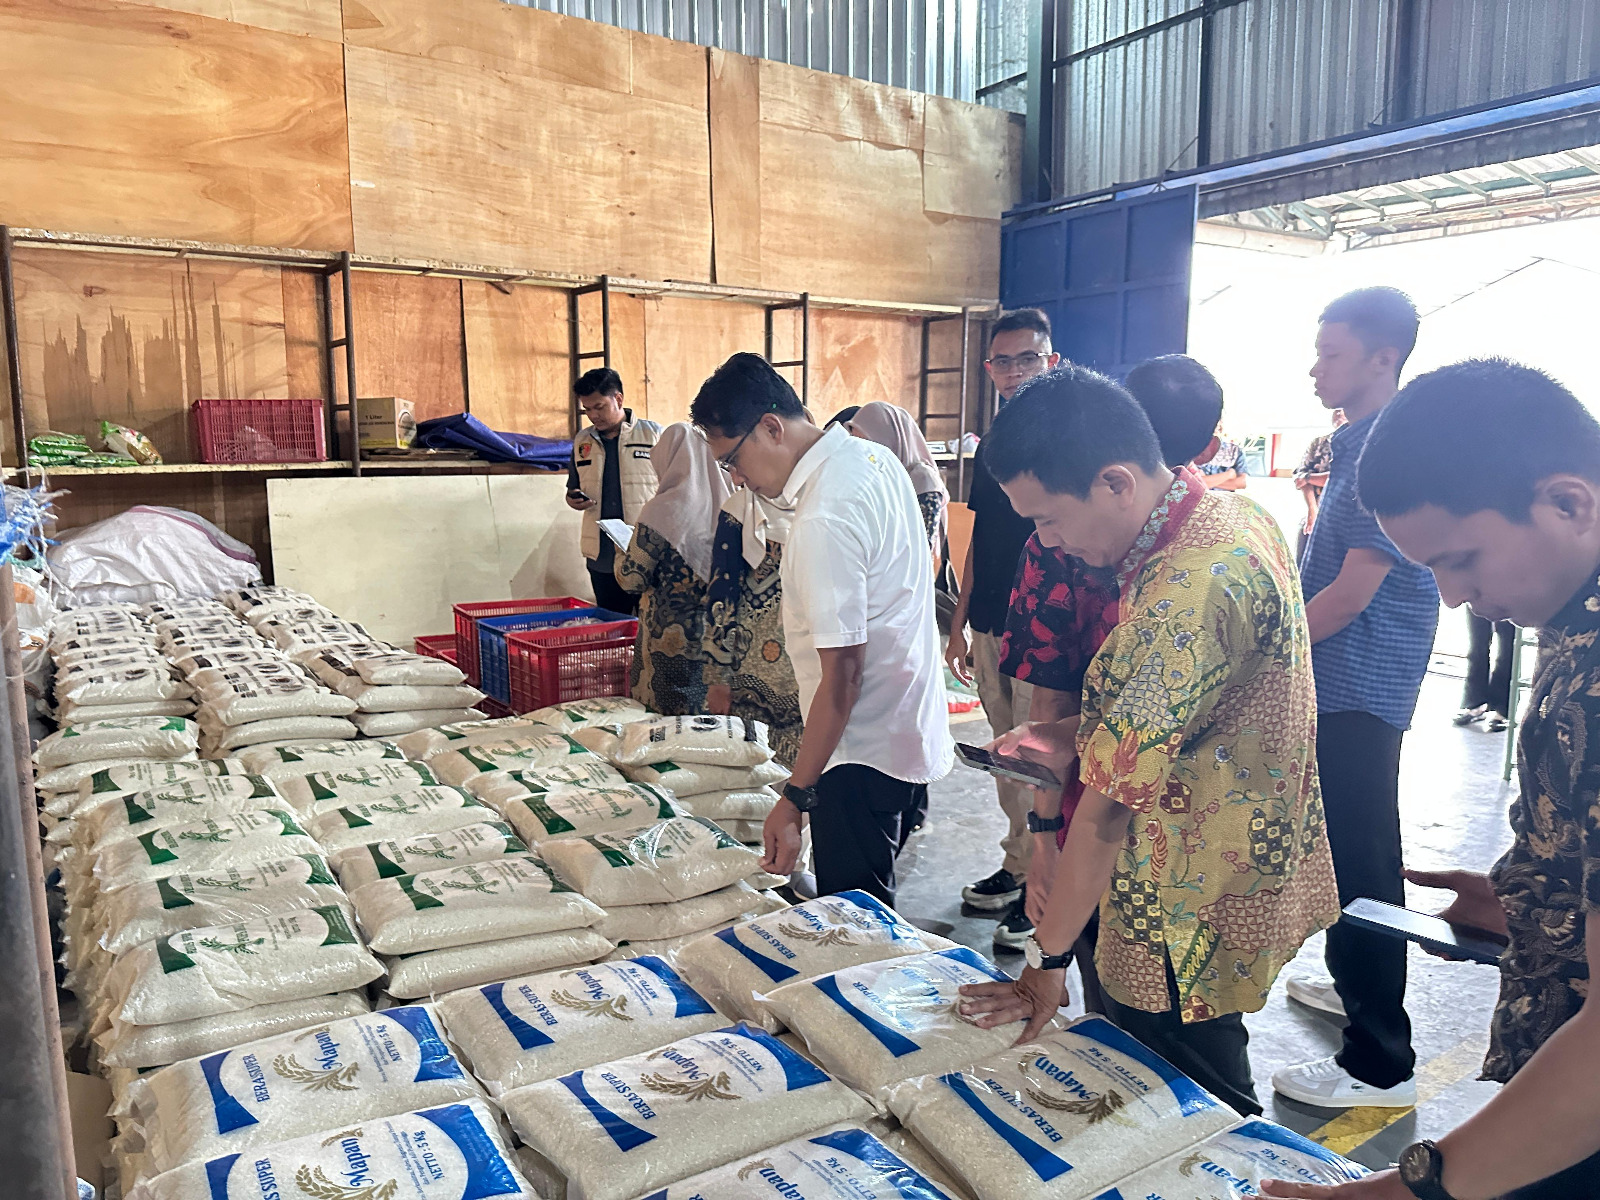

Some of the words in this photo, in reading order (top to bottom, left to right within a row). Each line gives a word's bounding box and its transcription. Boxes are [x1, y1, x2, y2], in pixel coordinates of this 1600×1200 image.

[748, 923, 773, 940] SUPER
[768, 938, 797, 960] BERAS
[518, 984, 541, 1004] SUPER
[576, 970, 611, 1000] Mapan
[639, 980, 659, 998] NETTO
[534, 1003, 558, 1025] BERAS
[314, 1031, 343, 1070] Mapan
[383, 1040, 402, 1061] NETTO
[737, 1049, 765, 1071] NETTO
[1088, 1047, 1103, 1057] Kg
[663, 1050, 709, 1080] Mapan
[1034, 1055, 1100, 1100] Mapan
[1114, 1065, 1151, 1091] NETTO
[601, 1072, 631, 1094] SUPER
[984, 1078, 1024, 1107] SUPER
[623, 1092, 657, 1120] BERAS
[413, 1130, 427, 1142] Kg
[1020, 1106, 1064, 1143] BERAS
[254, 1157, 278, 1192] SUPER
[339, 1137, 375, 1188] Mapan
[423, 1152, 445, 1180] NETTO
[825, 1156, 840, 1168] Kg
[759, 1167, 806, 1200] apan
[848, 1177, 878, 1200] ETTO
[1200, 1161, 1258, 1196] apan
